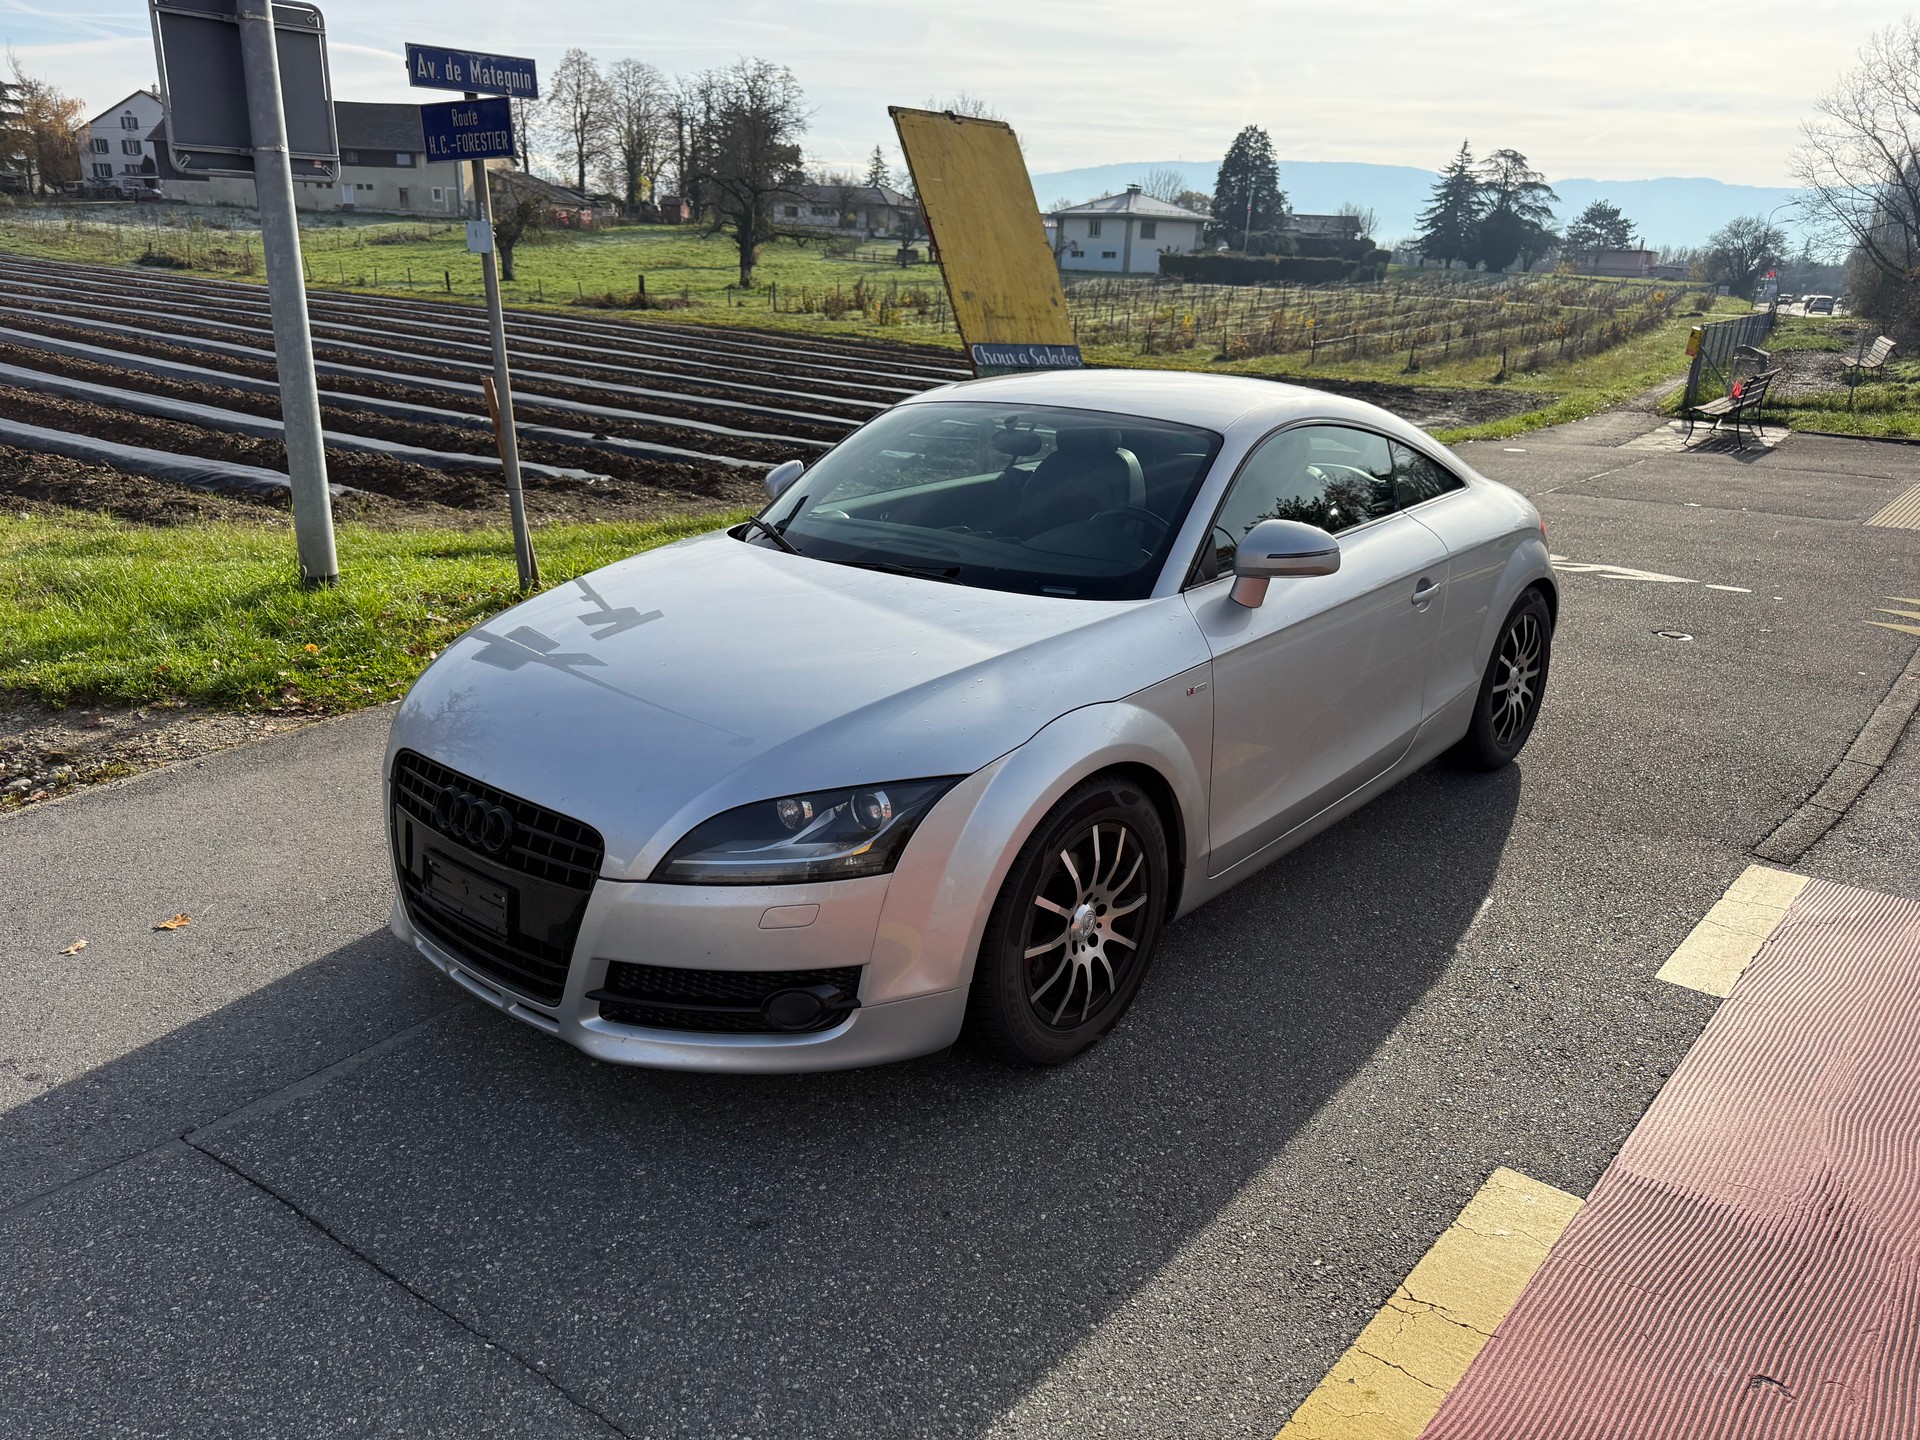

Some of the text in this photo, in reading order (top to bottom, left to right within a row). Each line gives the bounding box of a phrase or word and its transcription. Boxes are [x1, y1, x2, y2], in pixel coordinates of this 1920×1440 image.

[417, 53, 532, 94] Av. de Mategnin
[451, 108, 479, 127] Route
[1029, 347, 1082, 367] Salades
